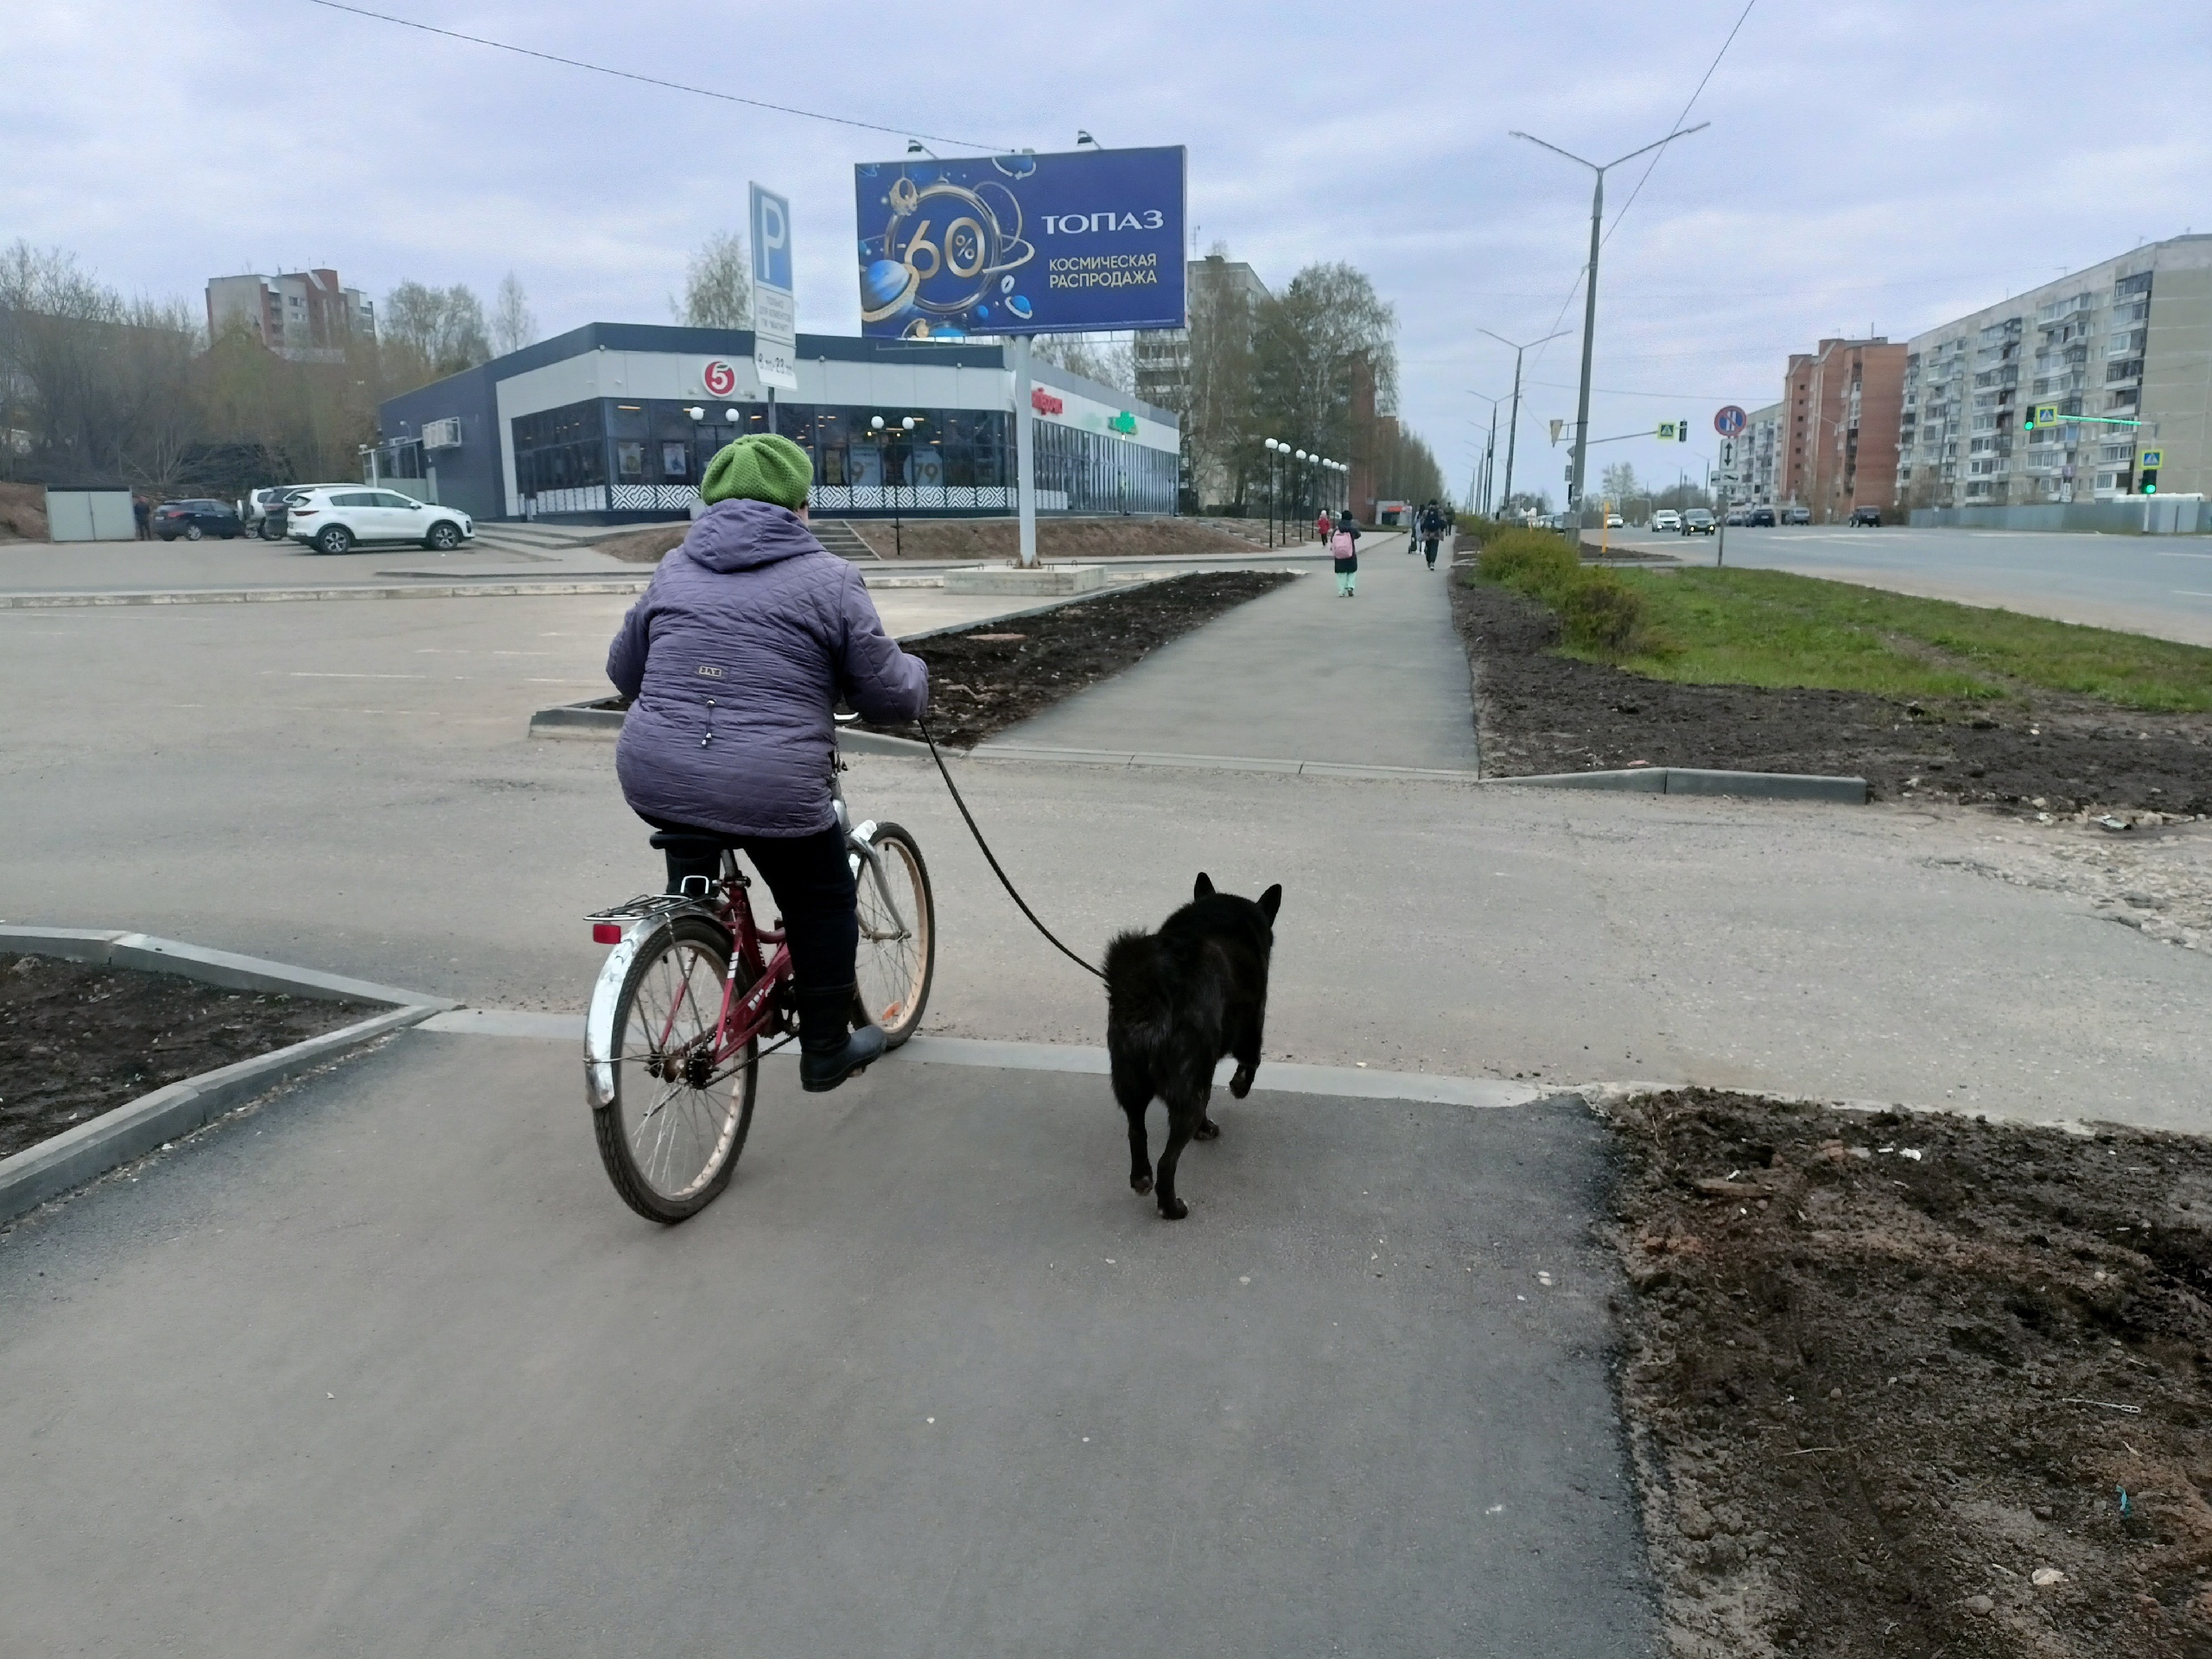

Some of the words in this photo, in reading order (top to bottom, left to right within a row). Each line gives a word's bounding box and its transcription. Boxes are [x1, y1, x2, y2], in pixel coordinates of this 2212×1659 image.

[1041, 210, 1164, 234] ТОПАЗ
[761, 195, 785, 279] P
[1049, 253, 1157, 271] КОСМИЧЕСКАЯ
[1049, 270, 1157, 288] РАСПРОДАЖА
[711, 363, 728, 390] 5
